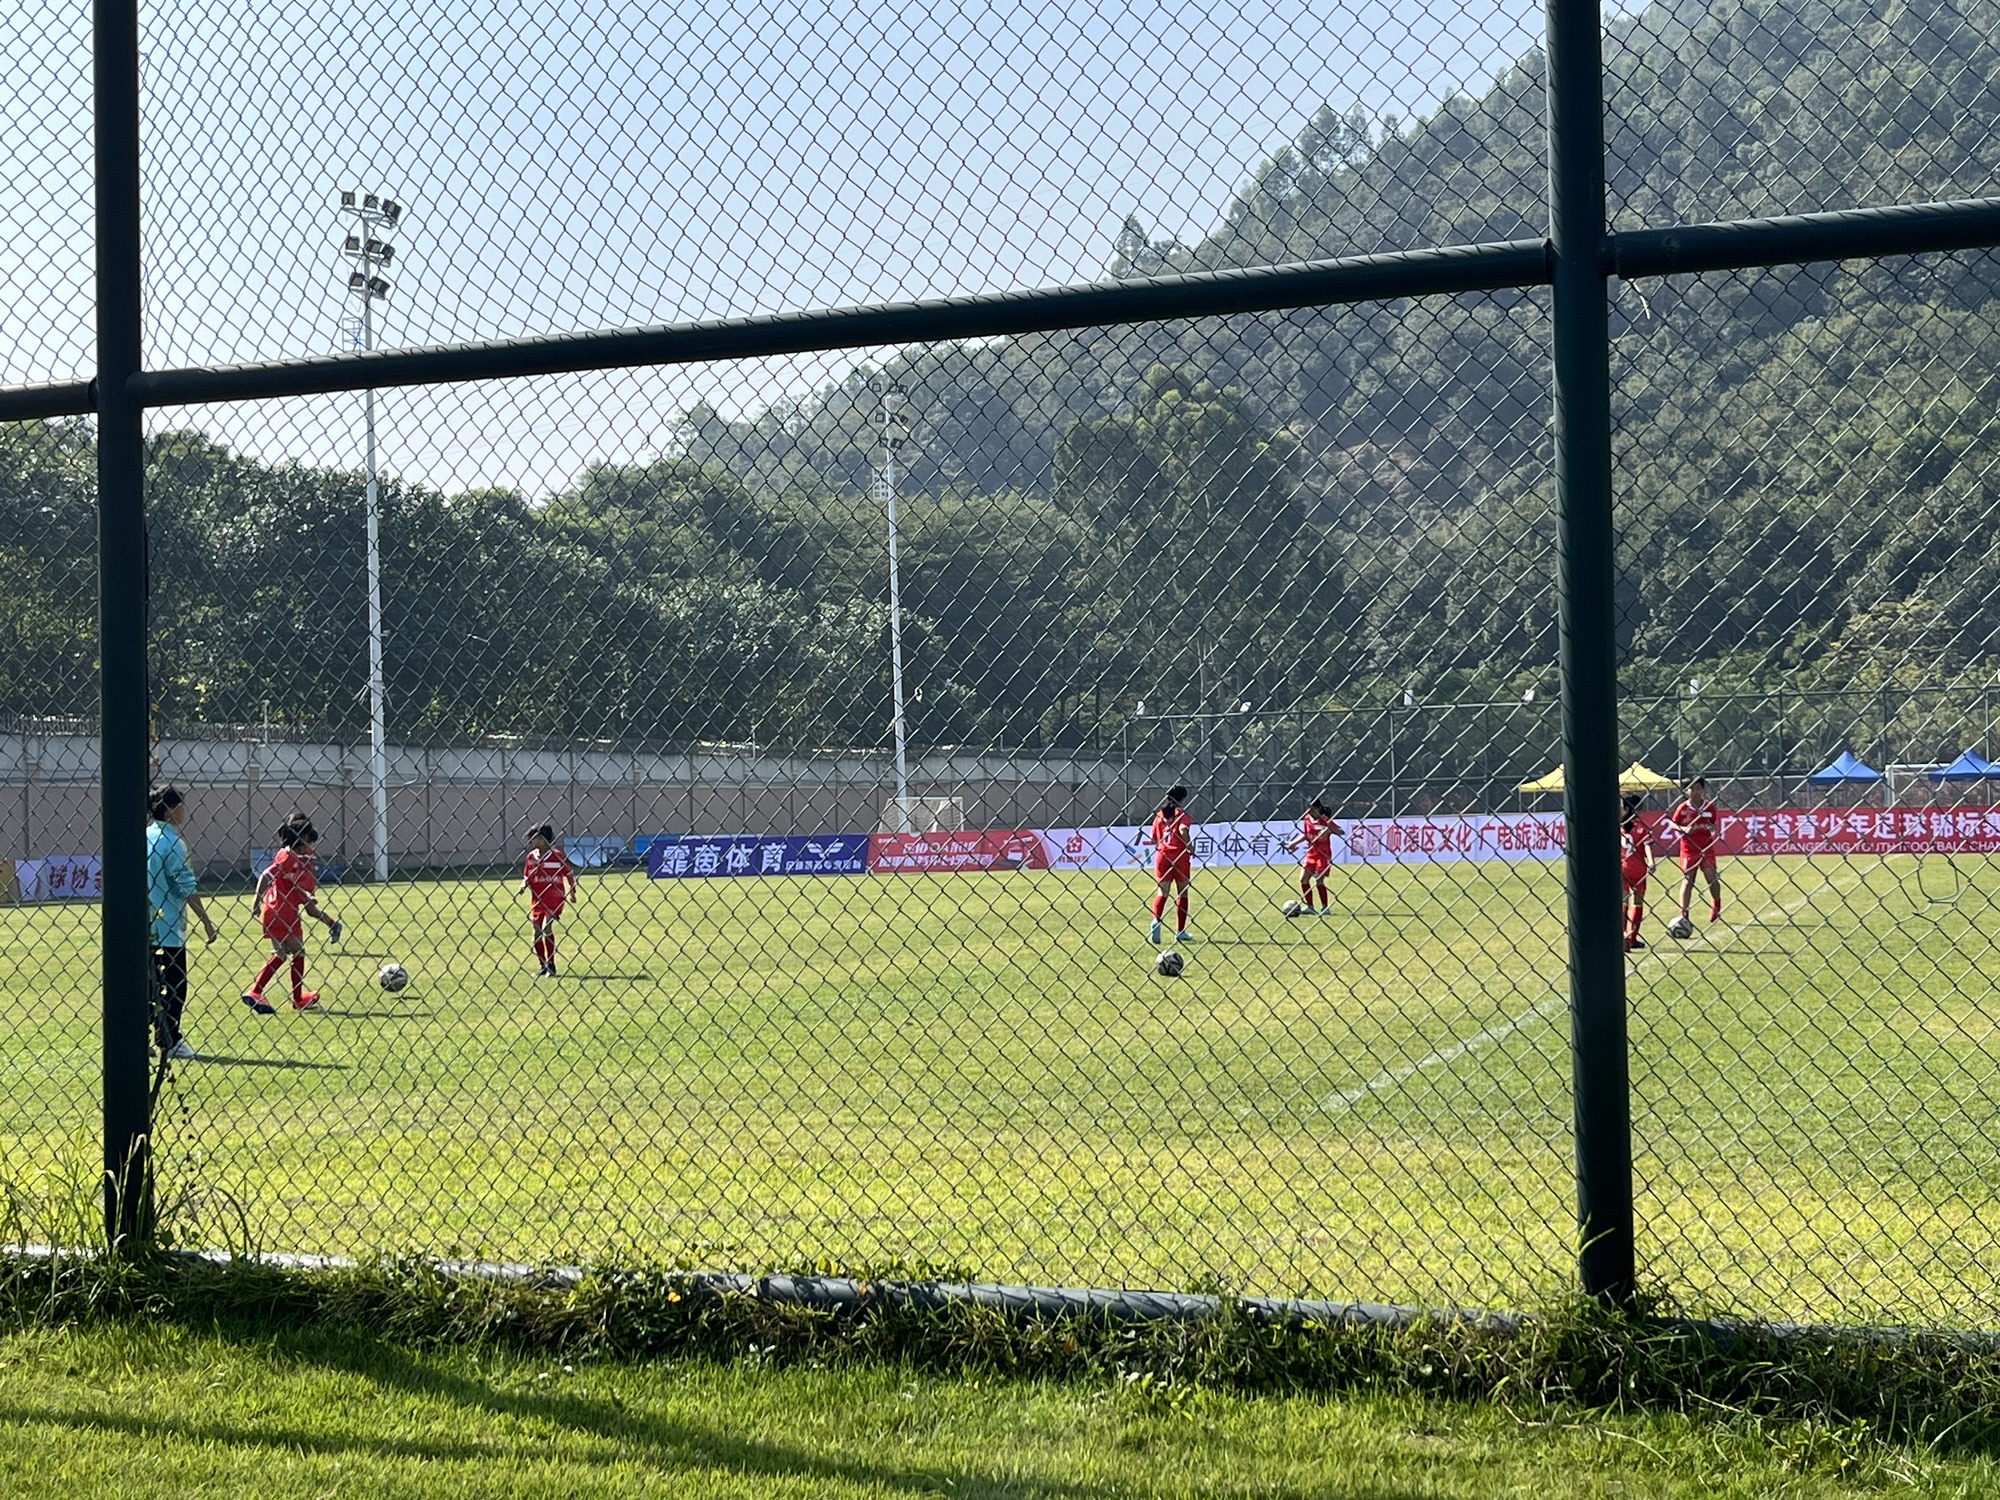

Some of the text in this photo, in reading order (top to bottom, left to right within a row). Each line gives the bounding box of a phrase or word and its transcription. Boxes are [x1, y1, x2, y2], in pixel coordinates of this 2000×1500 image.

[1660, 811, 2000, 840] 2广东省青少年足球锦标赛
[1191, 832, 1310, 859] 国体育彩
